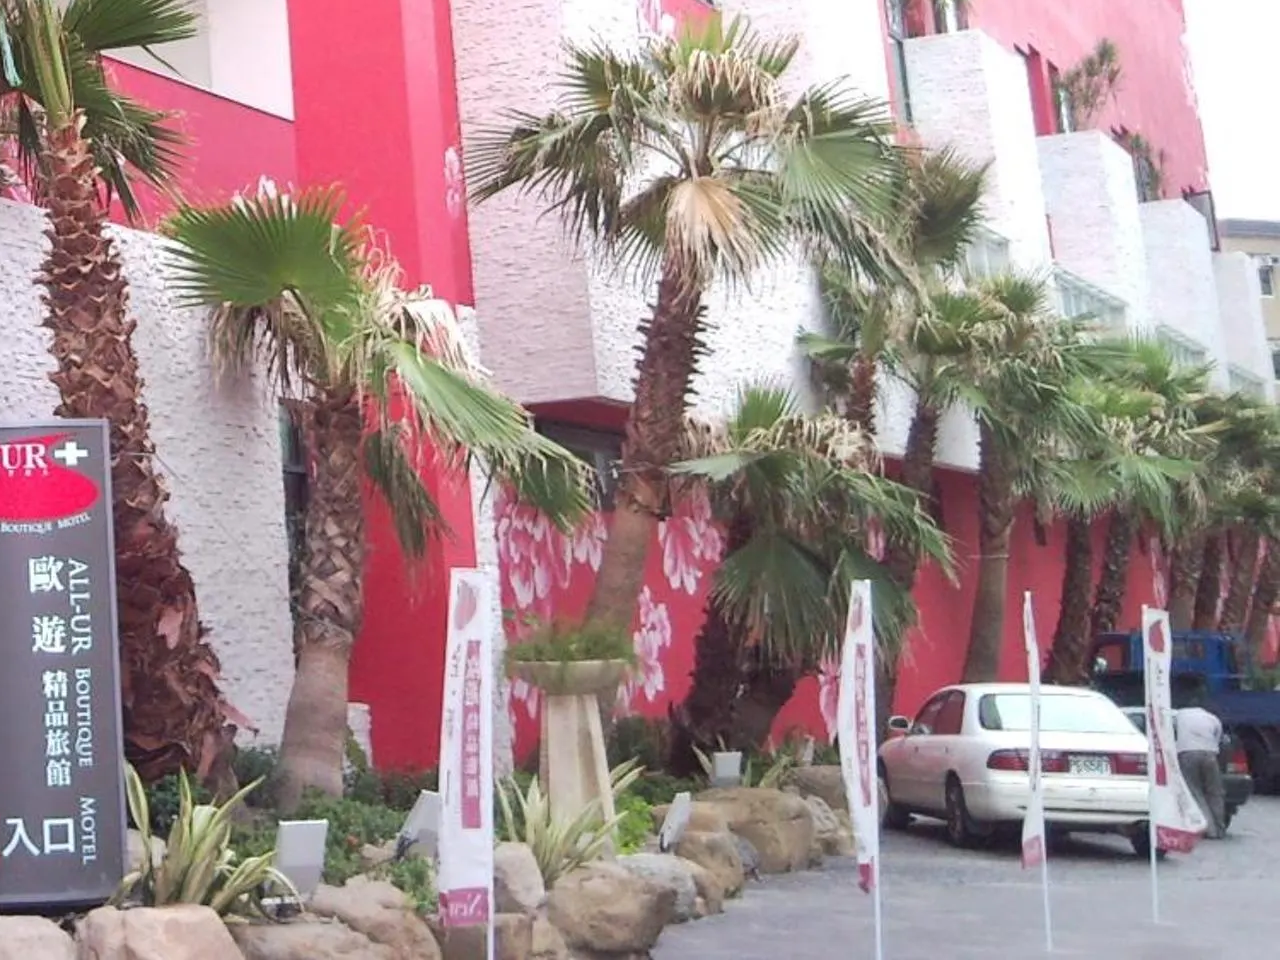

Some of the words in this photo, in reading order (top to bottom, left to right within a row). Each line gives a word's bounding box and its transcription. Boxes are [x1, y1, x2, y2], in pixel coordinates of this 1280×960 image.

[68, 558, 92, 654] ALL-UR
[42, 670, 72, 787] 精品旅館
[75, 668, 93, 767] BOUTIQUE
[1, 817, 76, 857] 入口
[79, 797, 97, 866] MOTEL
